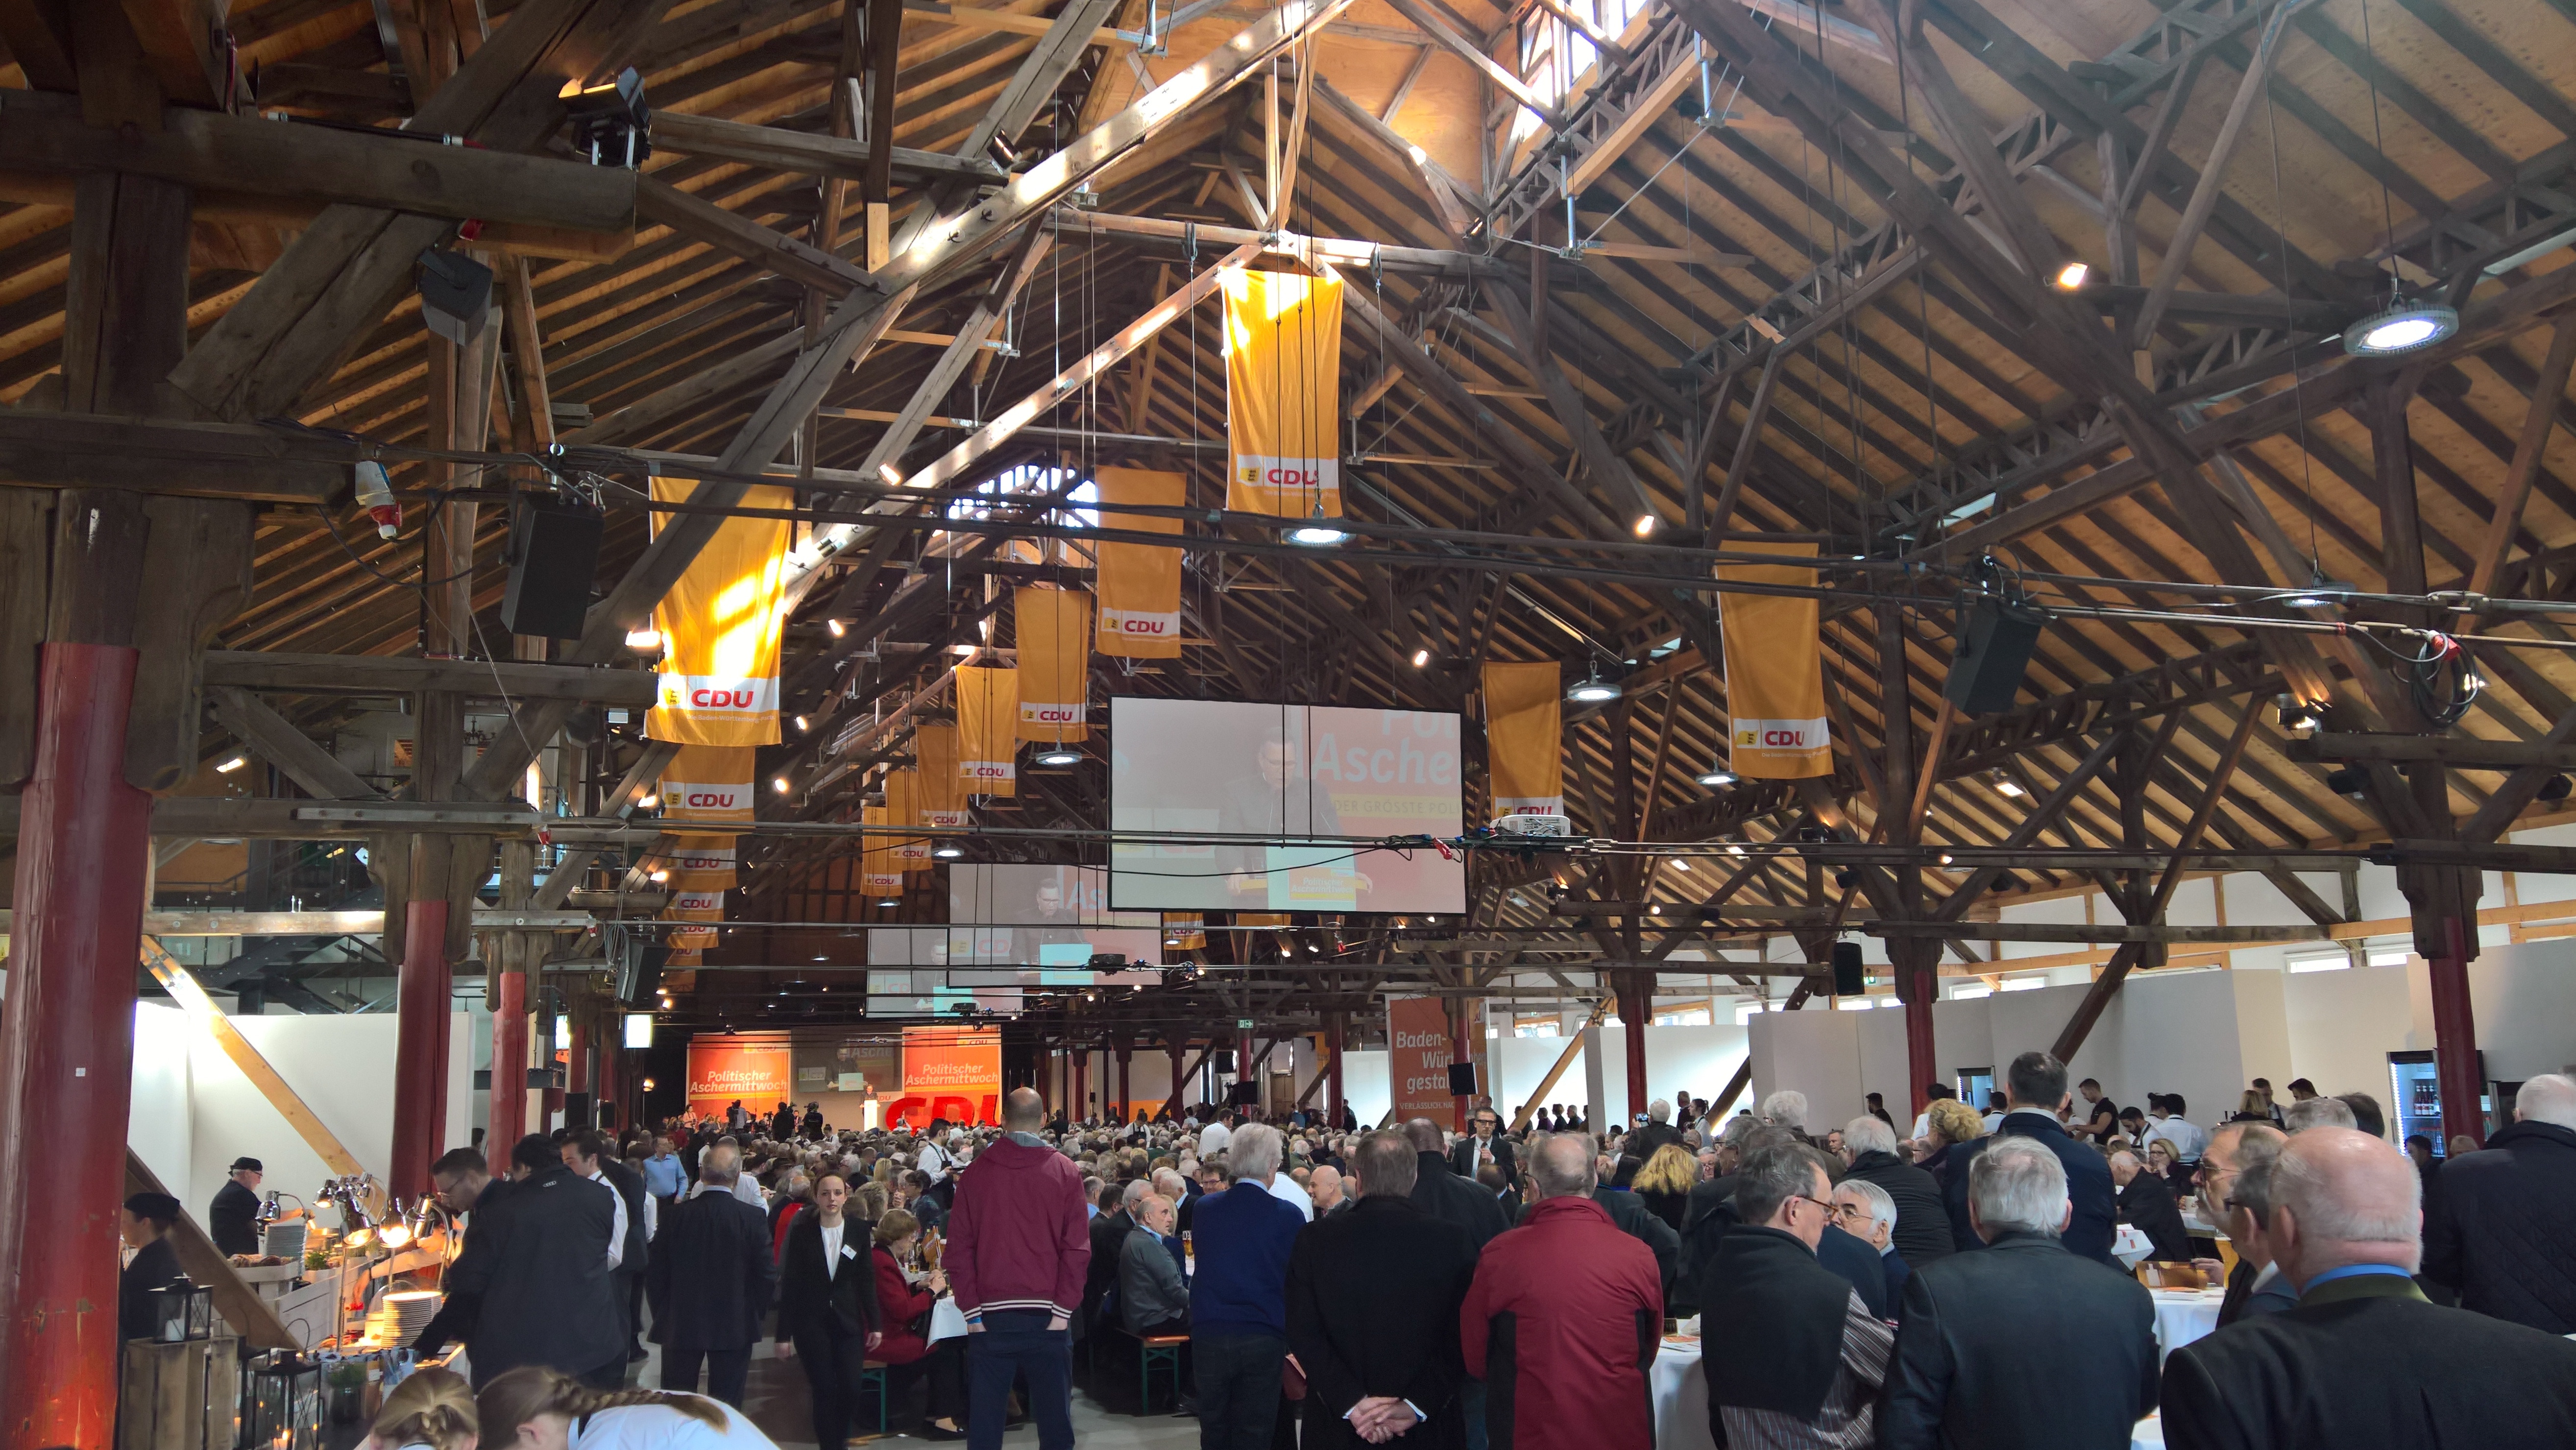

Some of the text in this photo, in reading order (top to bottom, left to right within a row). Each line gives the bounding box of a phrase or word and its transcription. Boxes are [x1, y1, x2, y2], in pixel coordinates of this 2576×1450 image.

[1267, 468, 1318, 485] CDU
[1124, 620, 1164, 633] CDU
[691, 689, 753, 708] CDU
[1040, 711, 1072, 721] CDU
[1765, 730, 1804, 746] CDU
[1311, 733, 1461, 785] Asche
[976, 768, 1004, 776] CDU
[688, 794, 734, 807] CDU
[1517, 806, 1552, 815] CDU
[682, 857, 720, 869] CDU
[1068, 881, 1109, 910] As
[680, 899, 711, 908] CDU
[1396, 1030, 1447, 1048] Baden-
[923, 1063, 984, 1075] Politischer
[707, 1070, 772, 1082] Politischer
[905, 1072, 998, 1086] Aschermittwoch
[689, 1079, 788, 1093] Aschermittwoch
